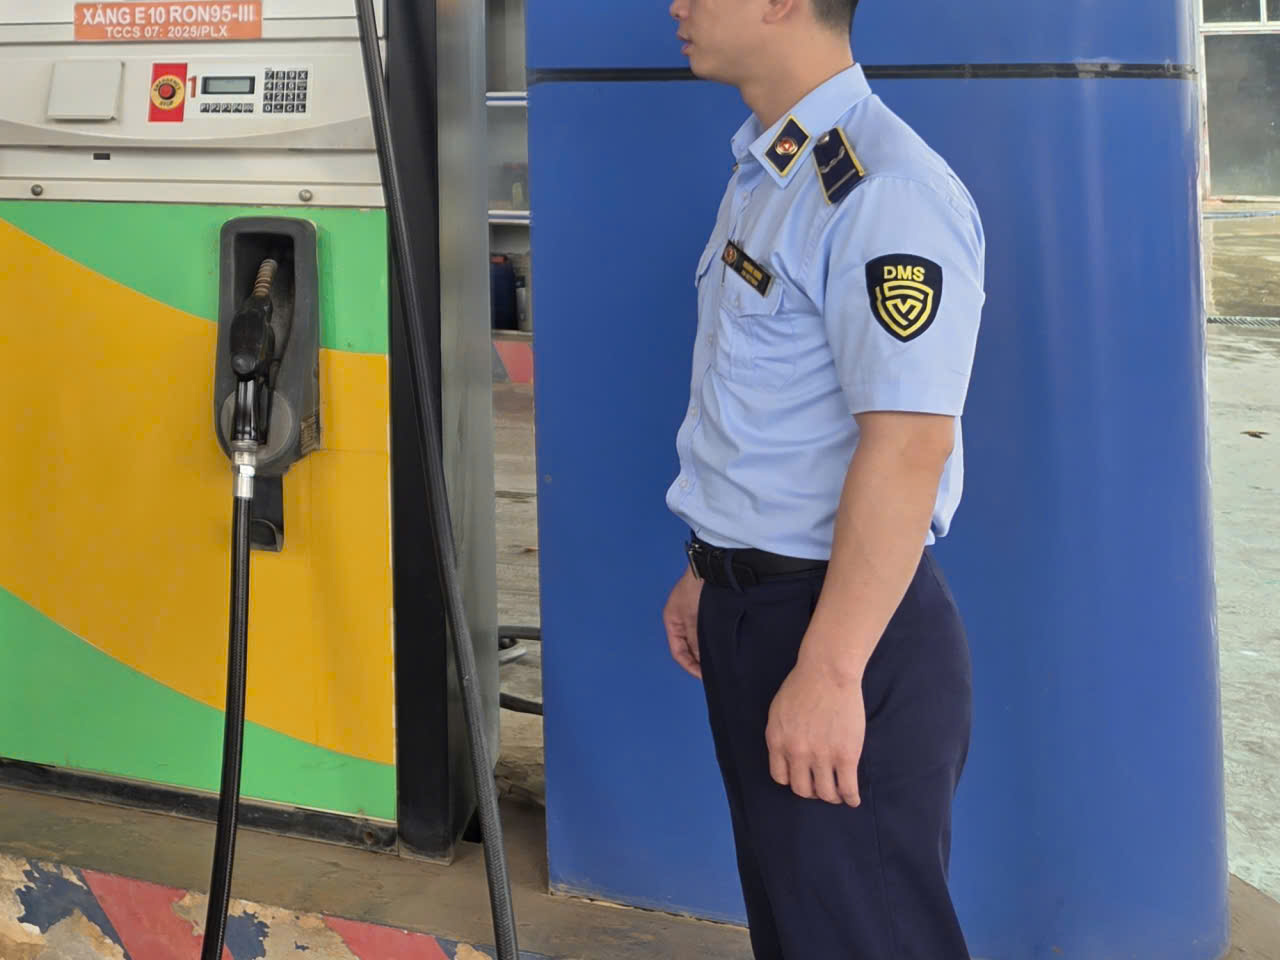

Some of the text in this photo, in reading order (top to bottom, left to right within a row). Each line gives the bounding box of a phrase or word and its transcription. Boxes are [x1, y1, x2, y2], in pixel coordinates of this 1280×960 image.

[82, 4, 131, 25] XĂNG
[169, 4, 255, 24] RON95-III
[105, 27, 141, 39] TCCS
[168, 25, 228, 38] 2025/PLX
[188, 75, 197, 98] 1
[883, 265, 925, 282] DMS
